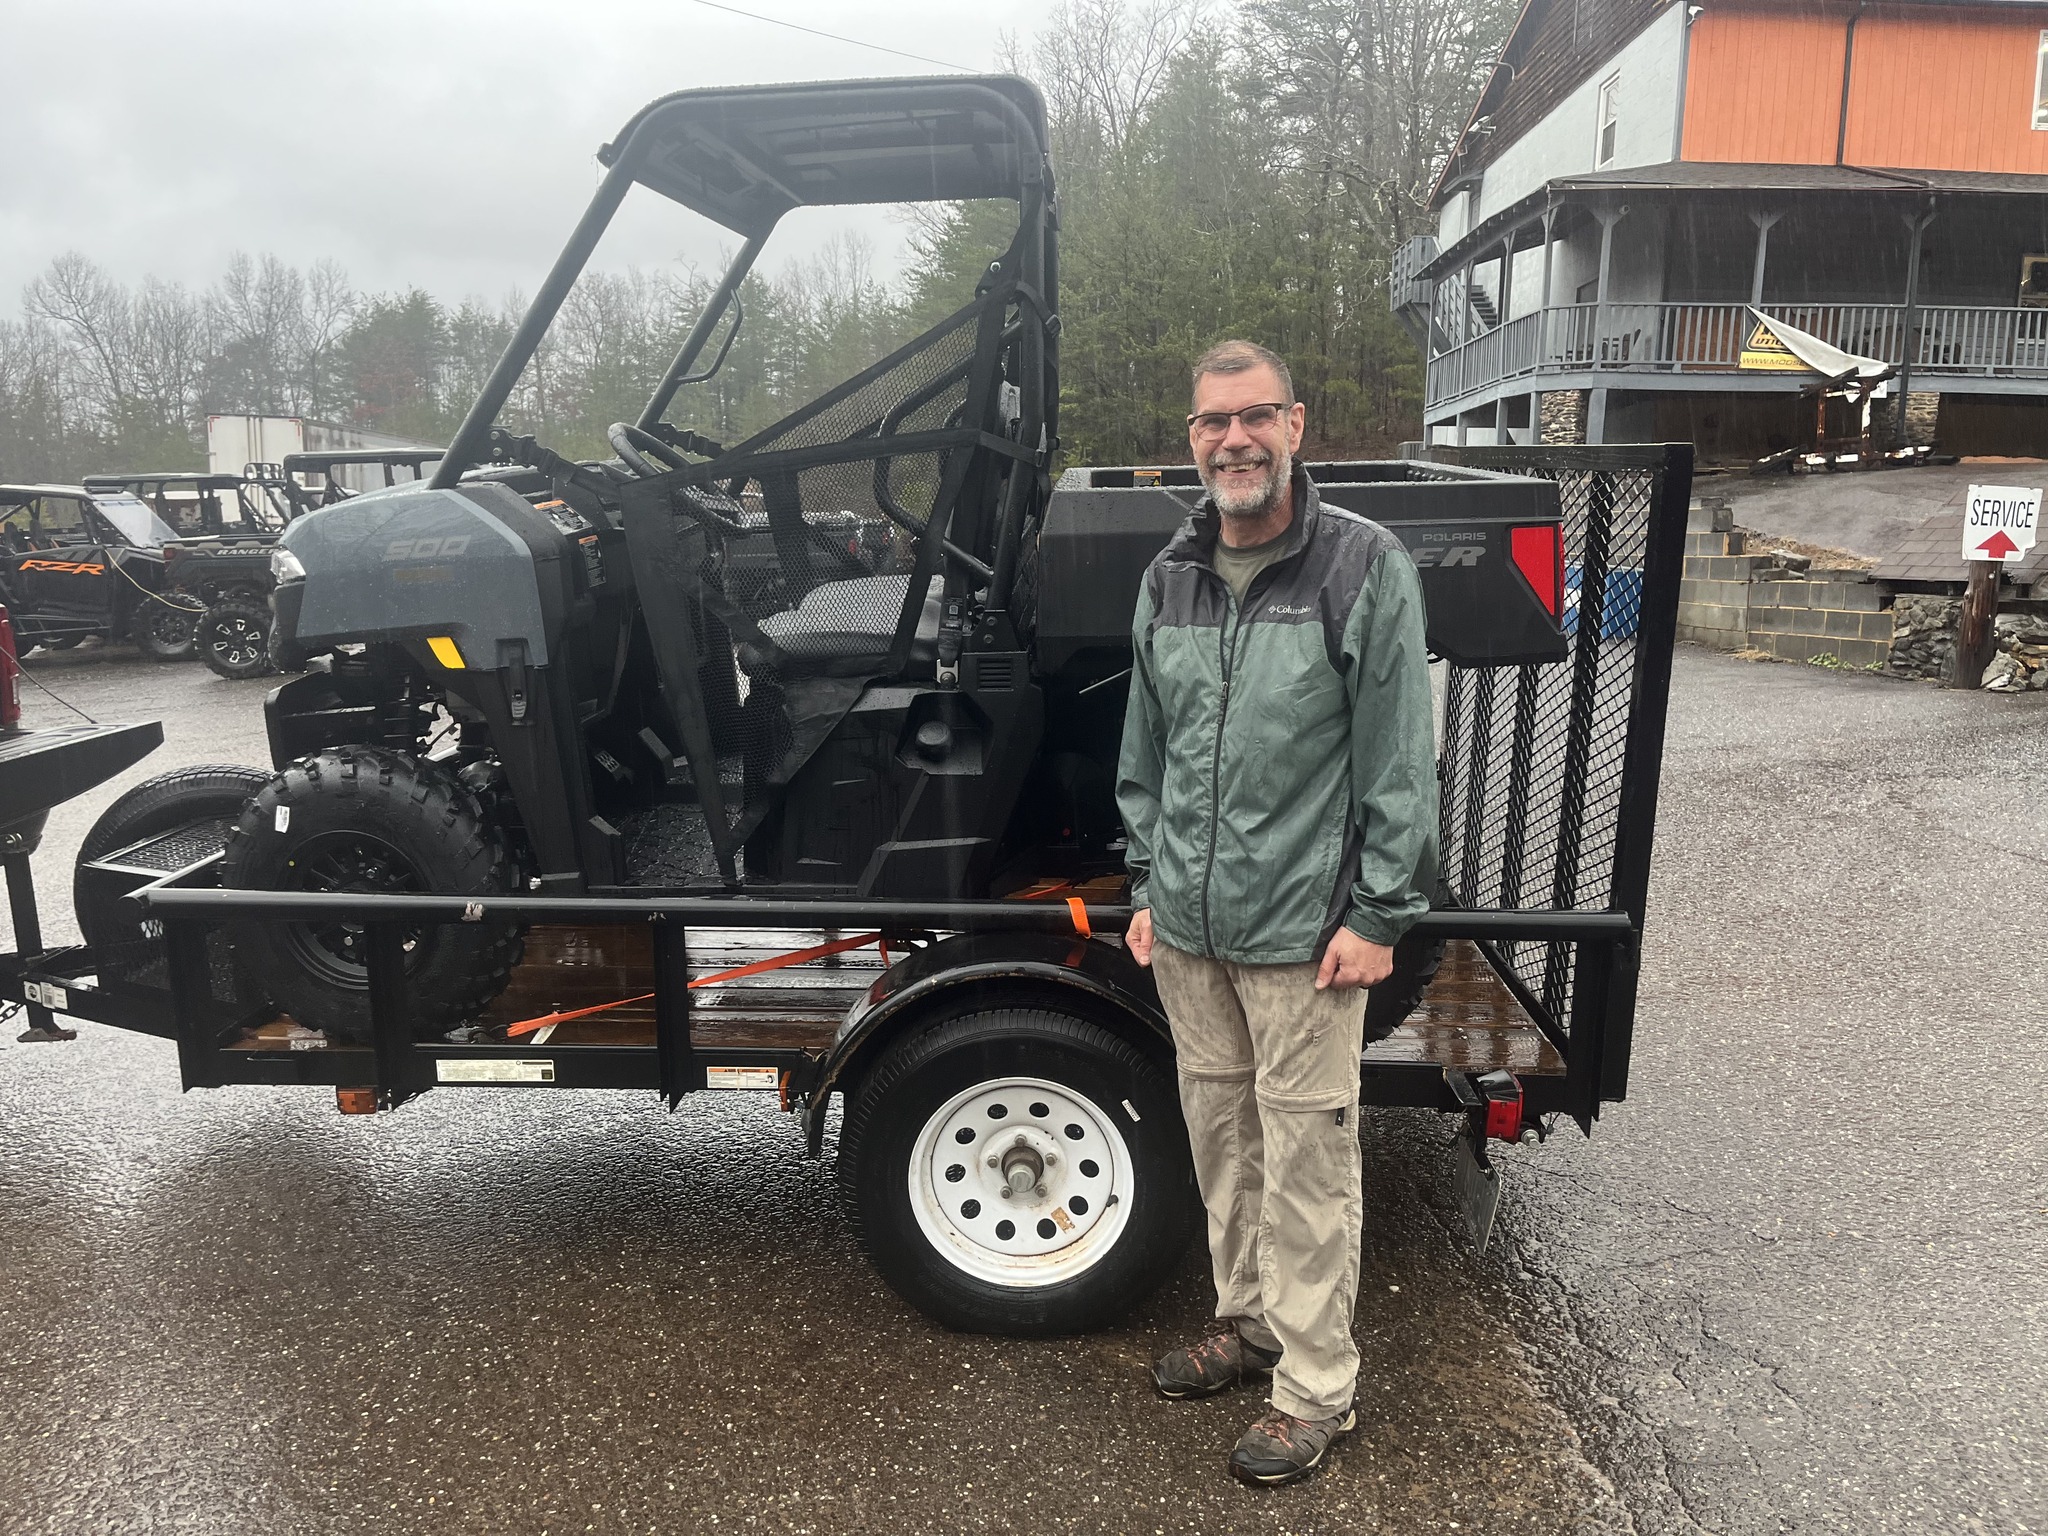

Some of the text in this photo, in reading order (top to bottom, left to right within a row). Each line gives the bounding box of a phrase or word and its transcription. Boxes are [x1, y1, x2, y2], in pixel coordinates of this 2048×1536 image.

[1755, 338, 1785, 346] UTIL
[1970, 498, 2035, 528] SERVICE
[1422, 532, 1487, 541] POLARIS
[381, 534, 472, 562] 500
[19, 559, 105, 576] RZR
[1276, 604, 1312, 615] Columbia
